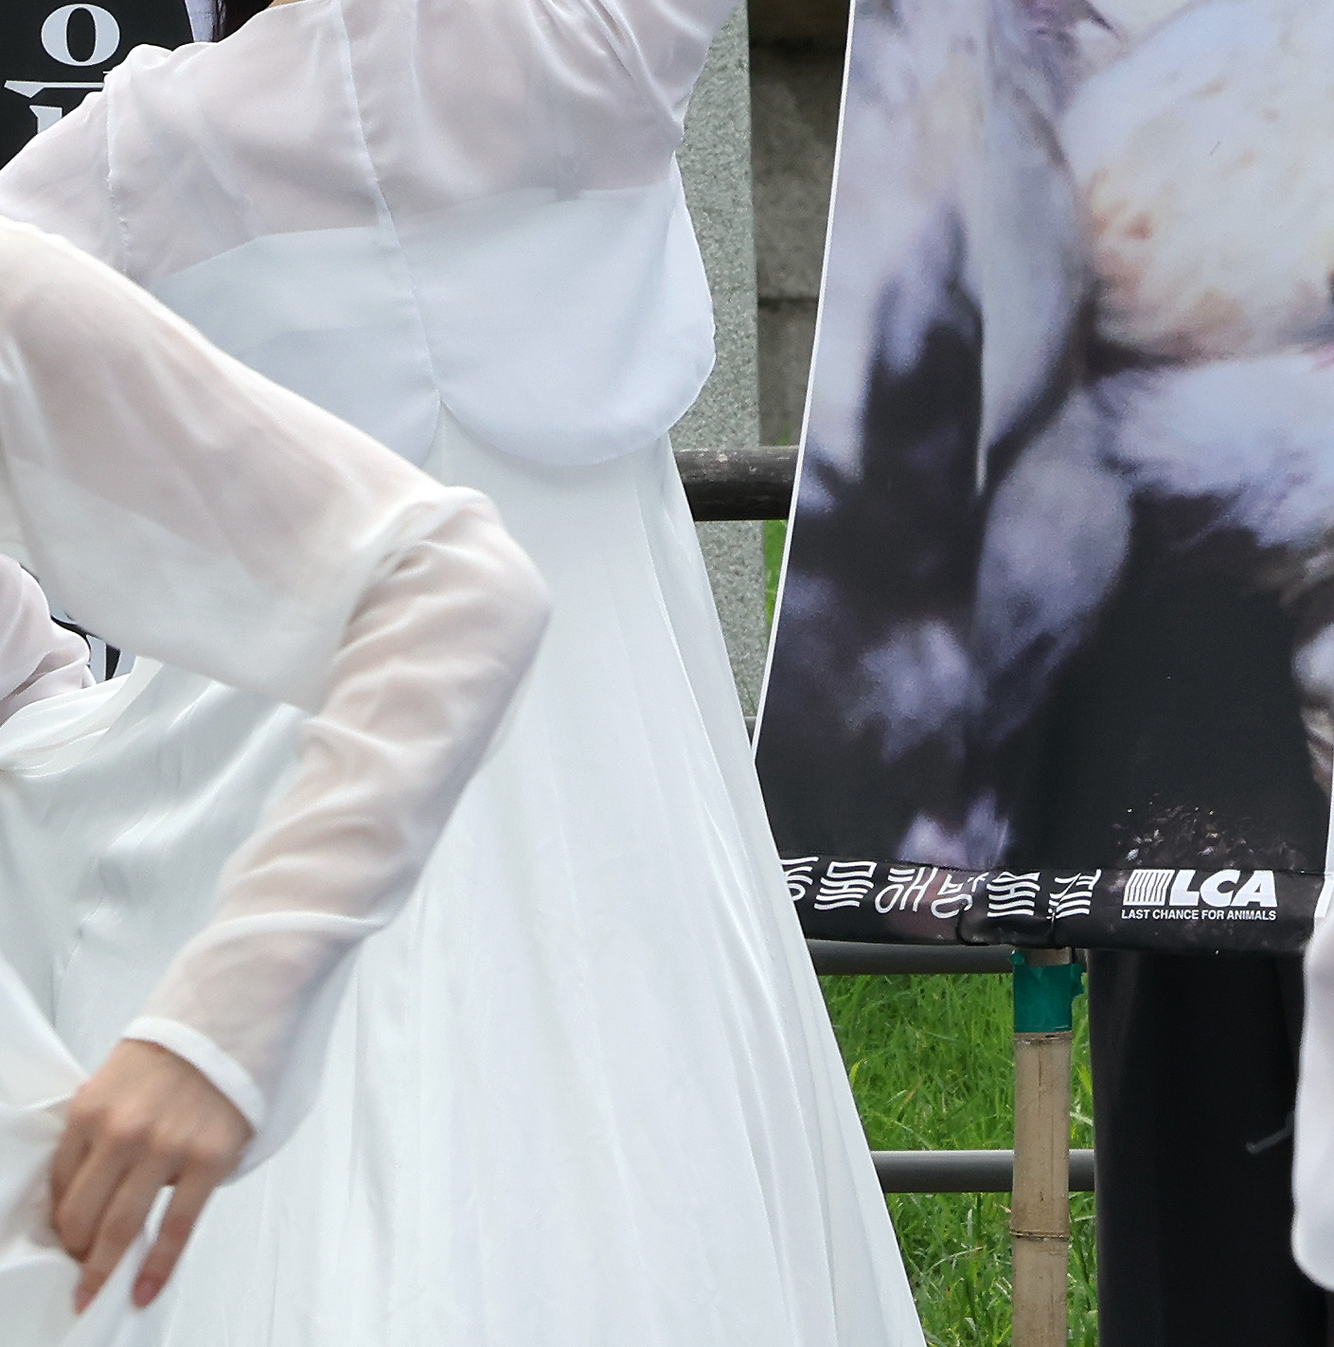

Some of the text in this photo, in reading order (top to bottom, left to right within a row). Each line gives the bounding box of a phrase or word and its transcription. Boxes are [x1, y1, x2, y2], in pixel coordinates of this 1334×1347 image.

[1168, 868, 1278, 908] LCA
[1121, 909, 1277, 921] LAST CHANCE FOR ANIMALS
